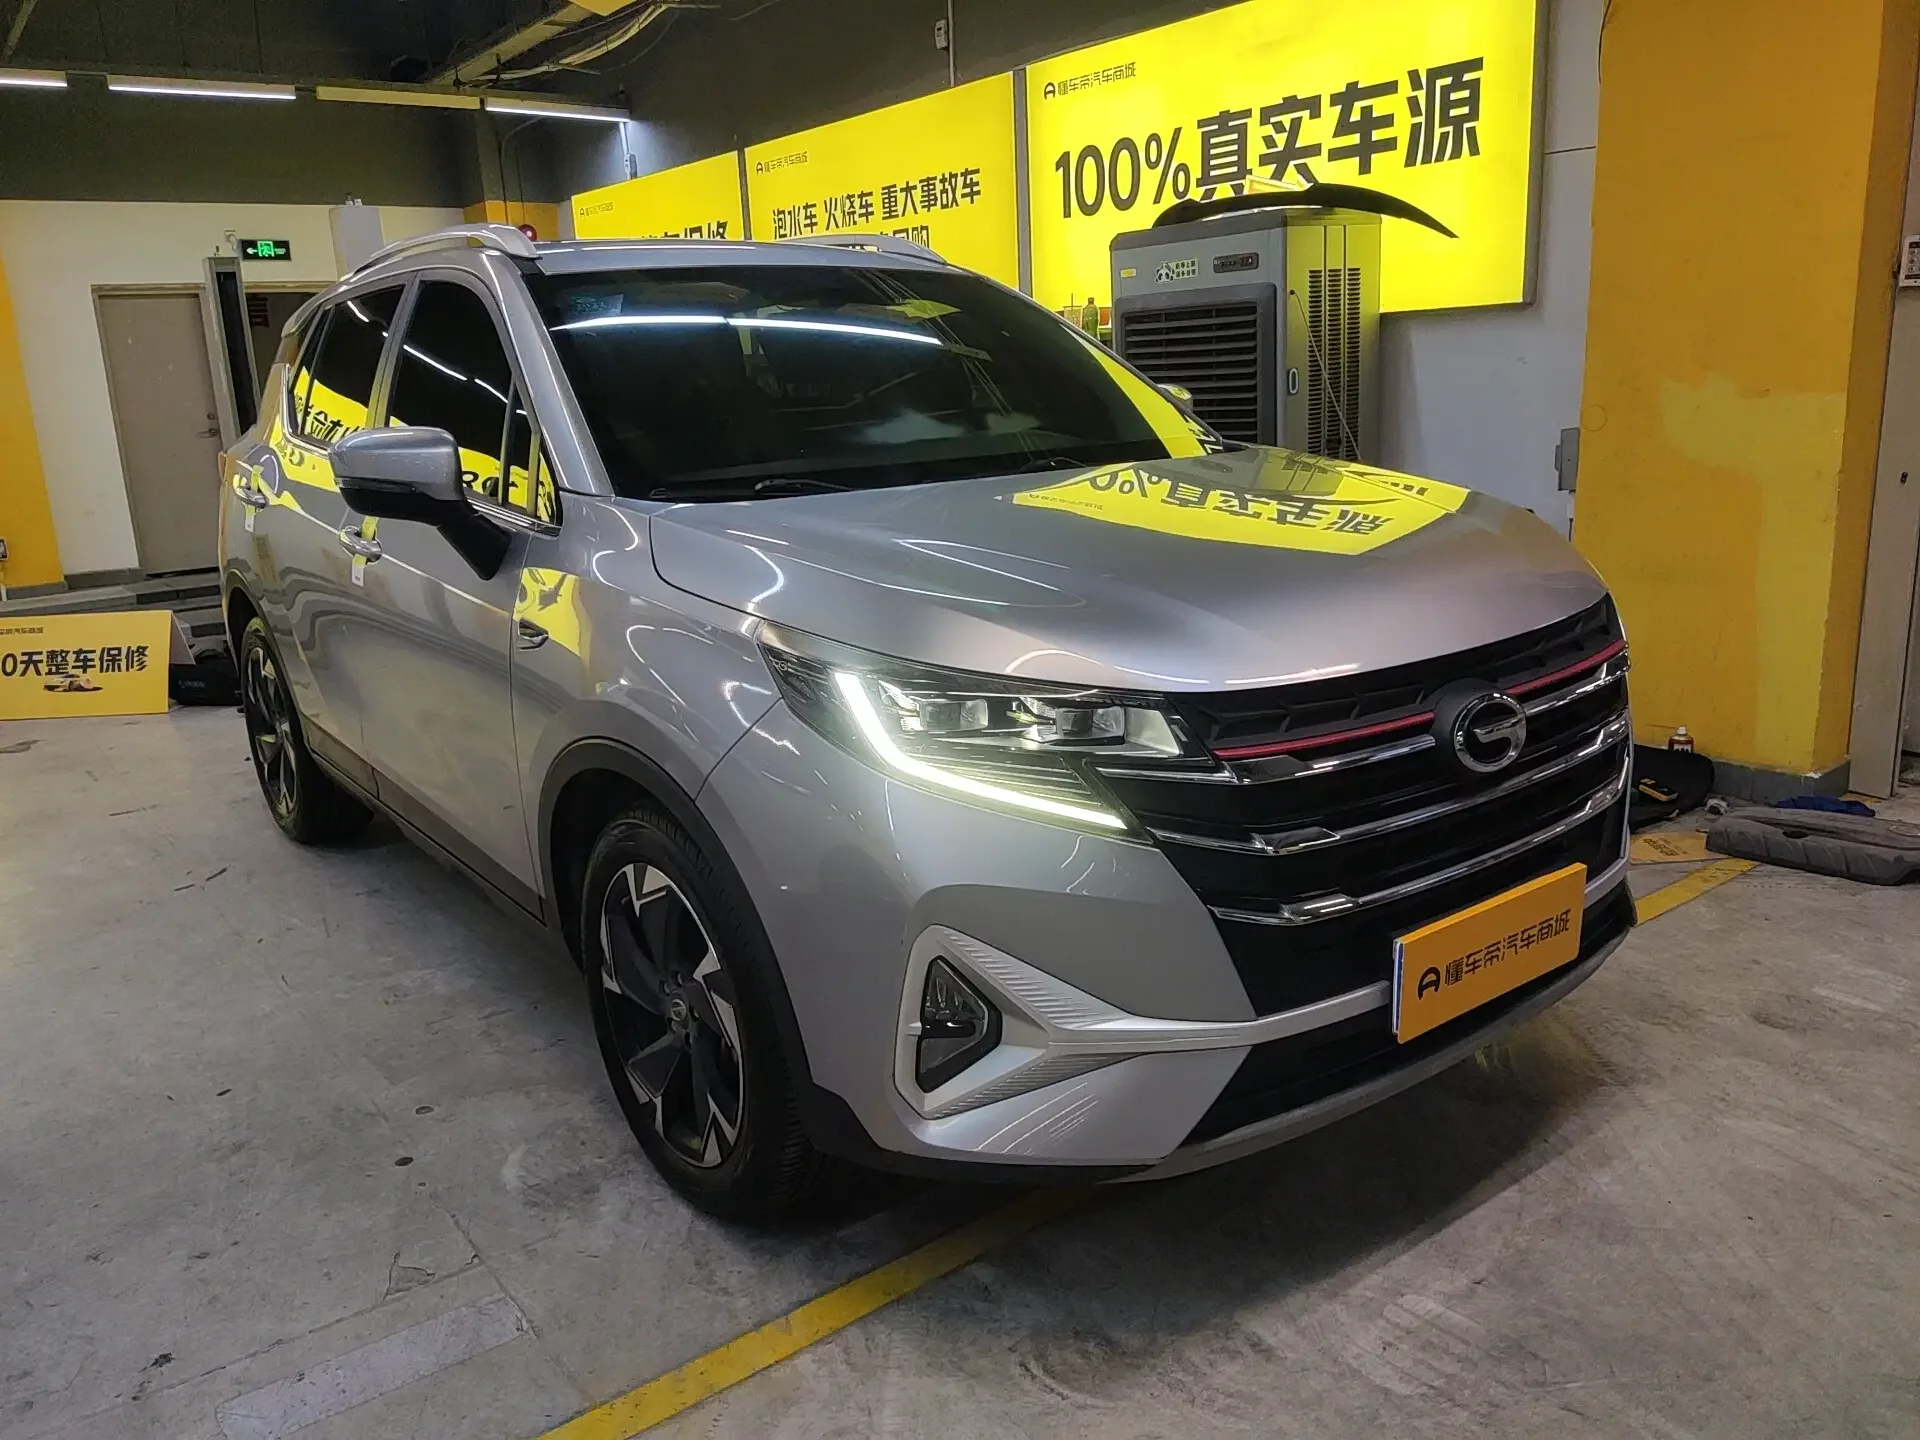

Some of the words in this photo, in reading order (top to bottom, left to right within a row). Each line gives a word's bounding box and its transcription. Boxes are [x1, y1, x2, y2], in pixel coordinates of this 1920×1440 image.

[1055, 57, 1484, 218] 100%真实车源
[772, 202, 818, 240] 泡水车
[823, 190, 875, 231] 火烧车
[881, 167, 982, 221] 重大事故车
[1, 645, 150, 677] 0天整车保修
[1444, 908, 1572, 987] 懂车帝汽车商城
